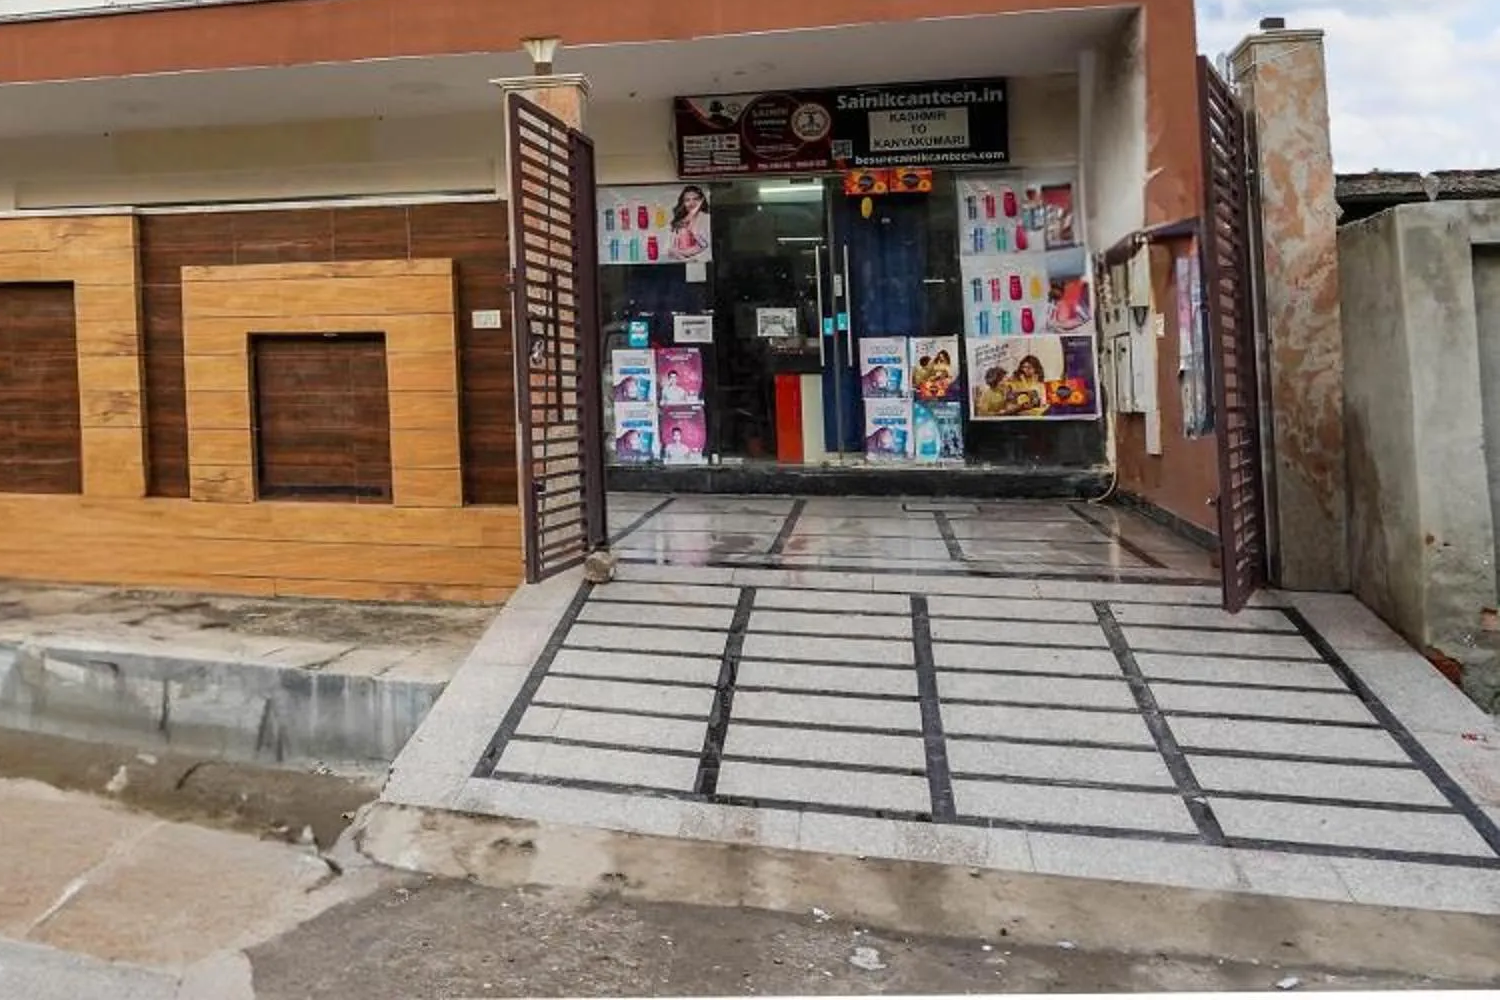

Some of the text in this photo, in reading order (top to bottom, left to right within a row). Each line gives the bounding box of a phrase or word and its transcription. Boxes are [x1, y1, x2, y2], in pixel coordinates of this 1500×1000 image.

[836, 87, 1003, 109] Sainikcanteen.in
[889, 110, 947, 122] KASHMIR
[910, 123, 927, 135] TO
[874, 135, 965, 149] KANYAKUMARI
